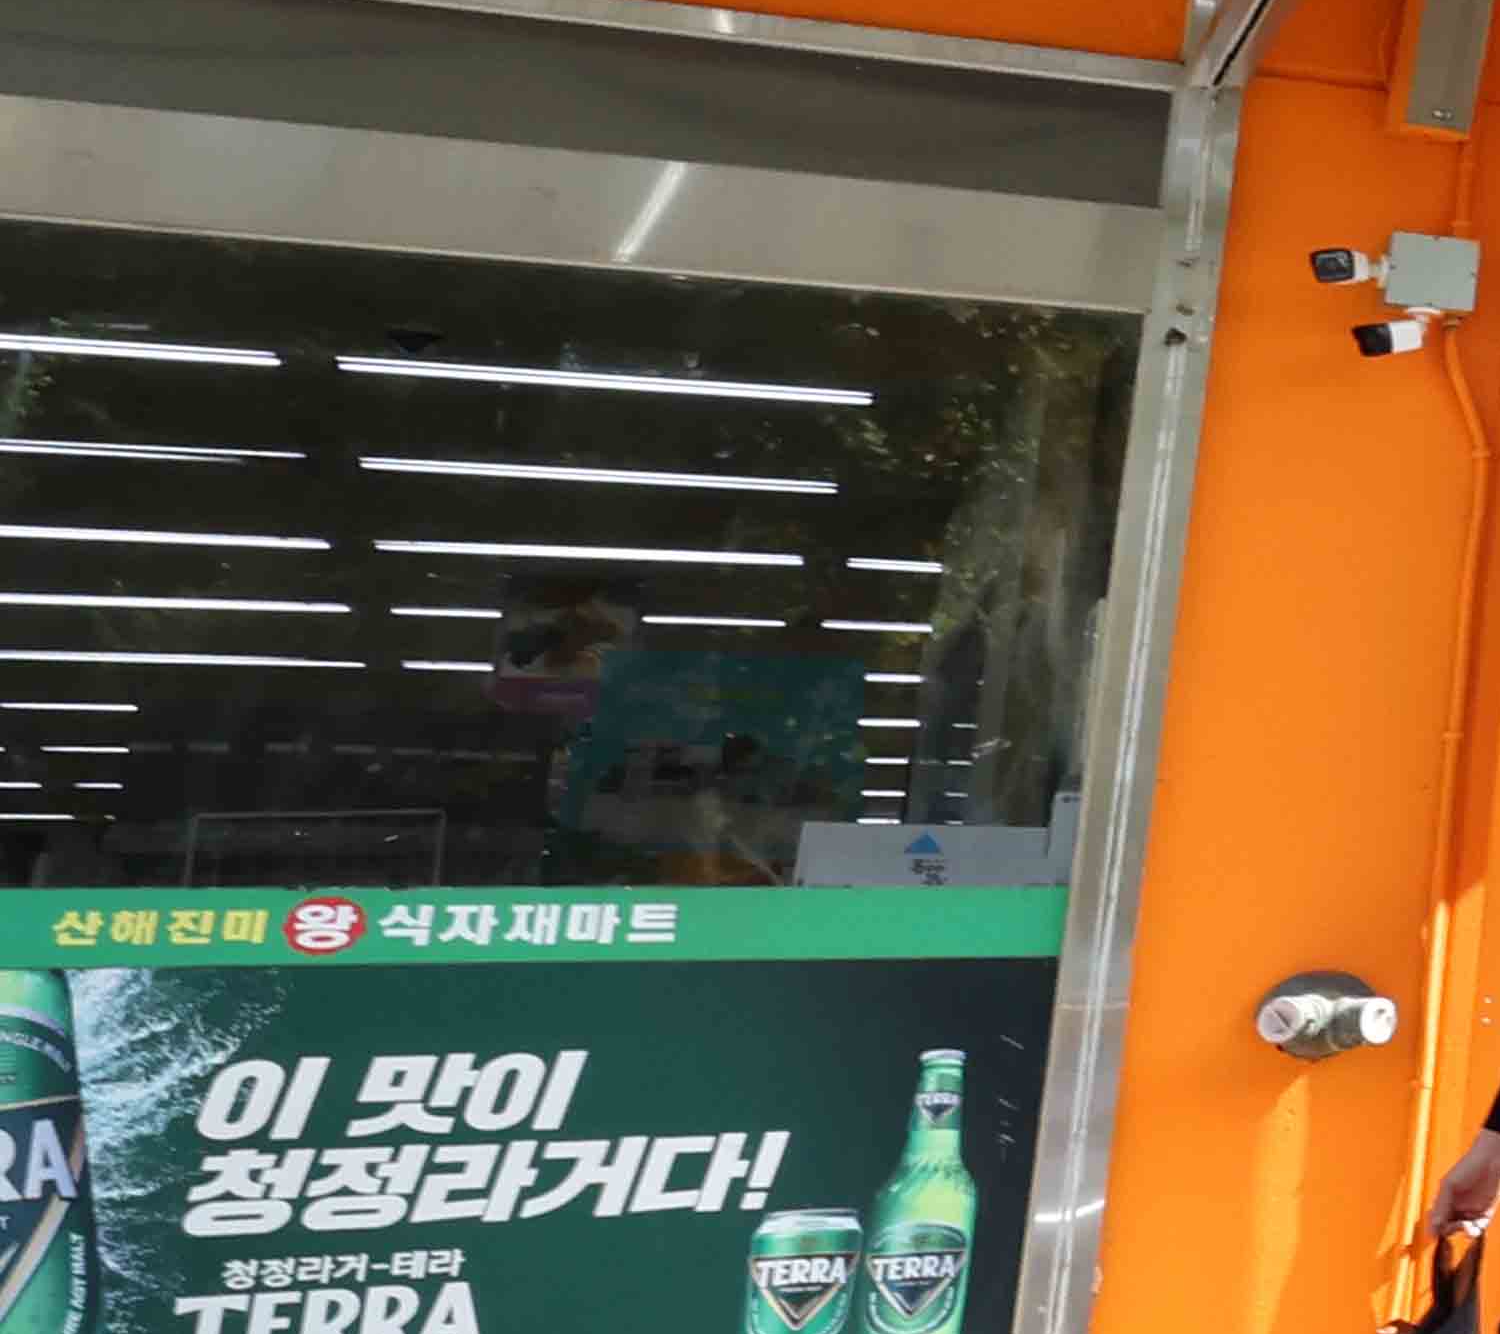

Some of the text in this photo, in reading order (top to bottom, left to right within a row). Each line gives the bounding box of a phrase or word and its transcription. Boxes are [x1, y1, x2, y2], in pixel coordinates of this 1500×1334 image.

[51, 902, 681, 950] 산해진미 왕 식자재마트
[194, 1048, 589, 1142] 이 맛이
[180, 1130, 792, 1238] 청정라거다!
[68, 1231, 87, 1275] MALT
[219, 1247, 467, 1291] 청정라거-테라
[755, 1255, 848, 1287] TERRA
[869, 1254, 957, 1281] TERRA
